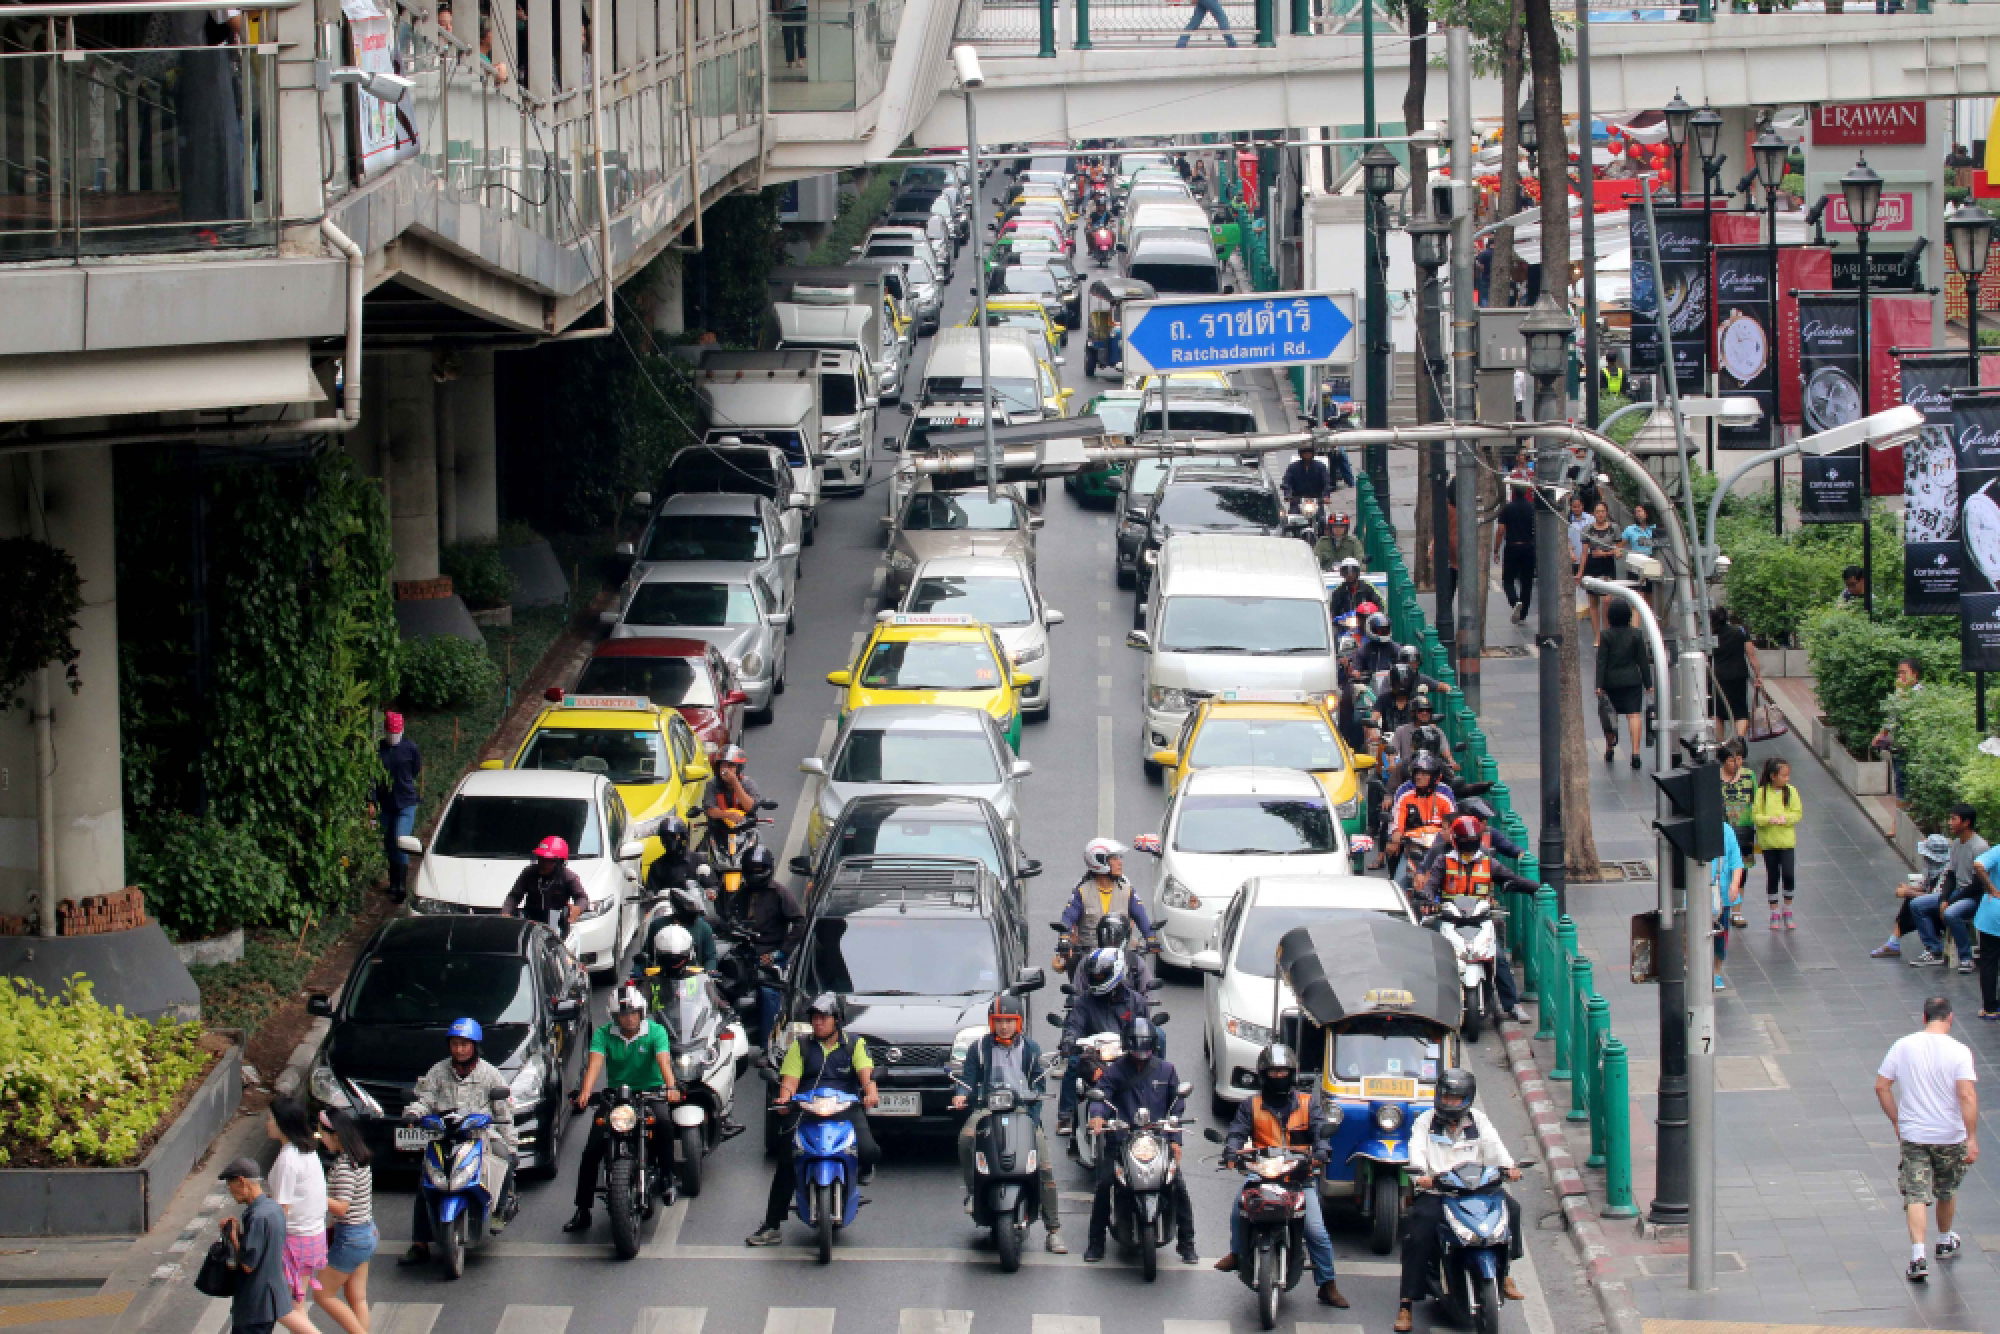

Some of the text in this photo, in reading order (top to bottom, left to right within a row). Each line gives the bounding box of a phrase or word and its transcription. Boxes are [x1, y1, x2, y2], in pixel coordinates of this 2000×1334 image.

[1821, 104, 1918, 128] ERAWAN
[1169, 298, 1311, 341] ถ. ราชดำริ
[1171, 341, 1312, 363] Ratchadamri Rd.
[1701, 1036, 1711, 1055] 7
